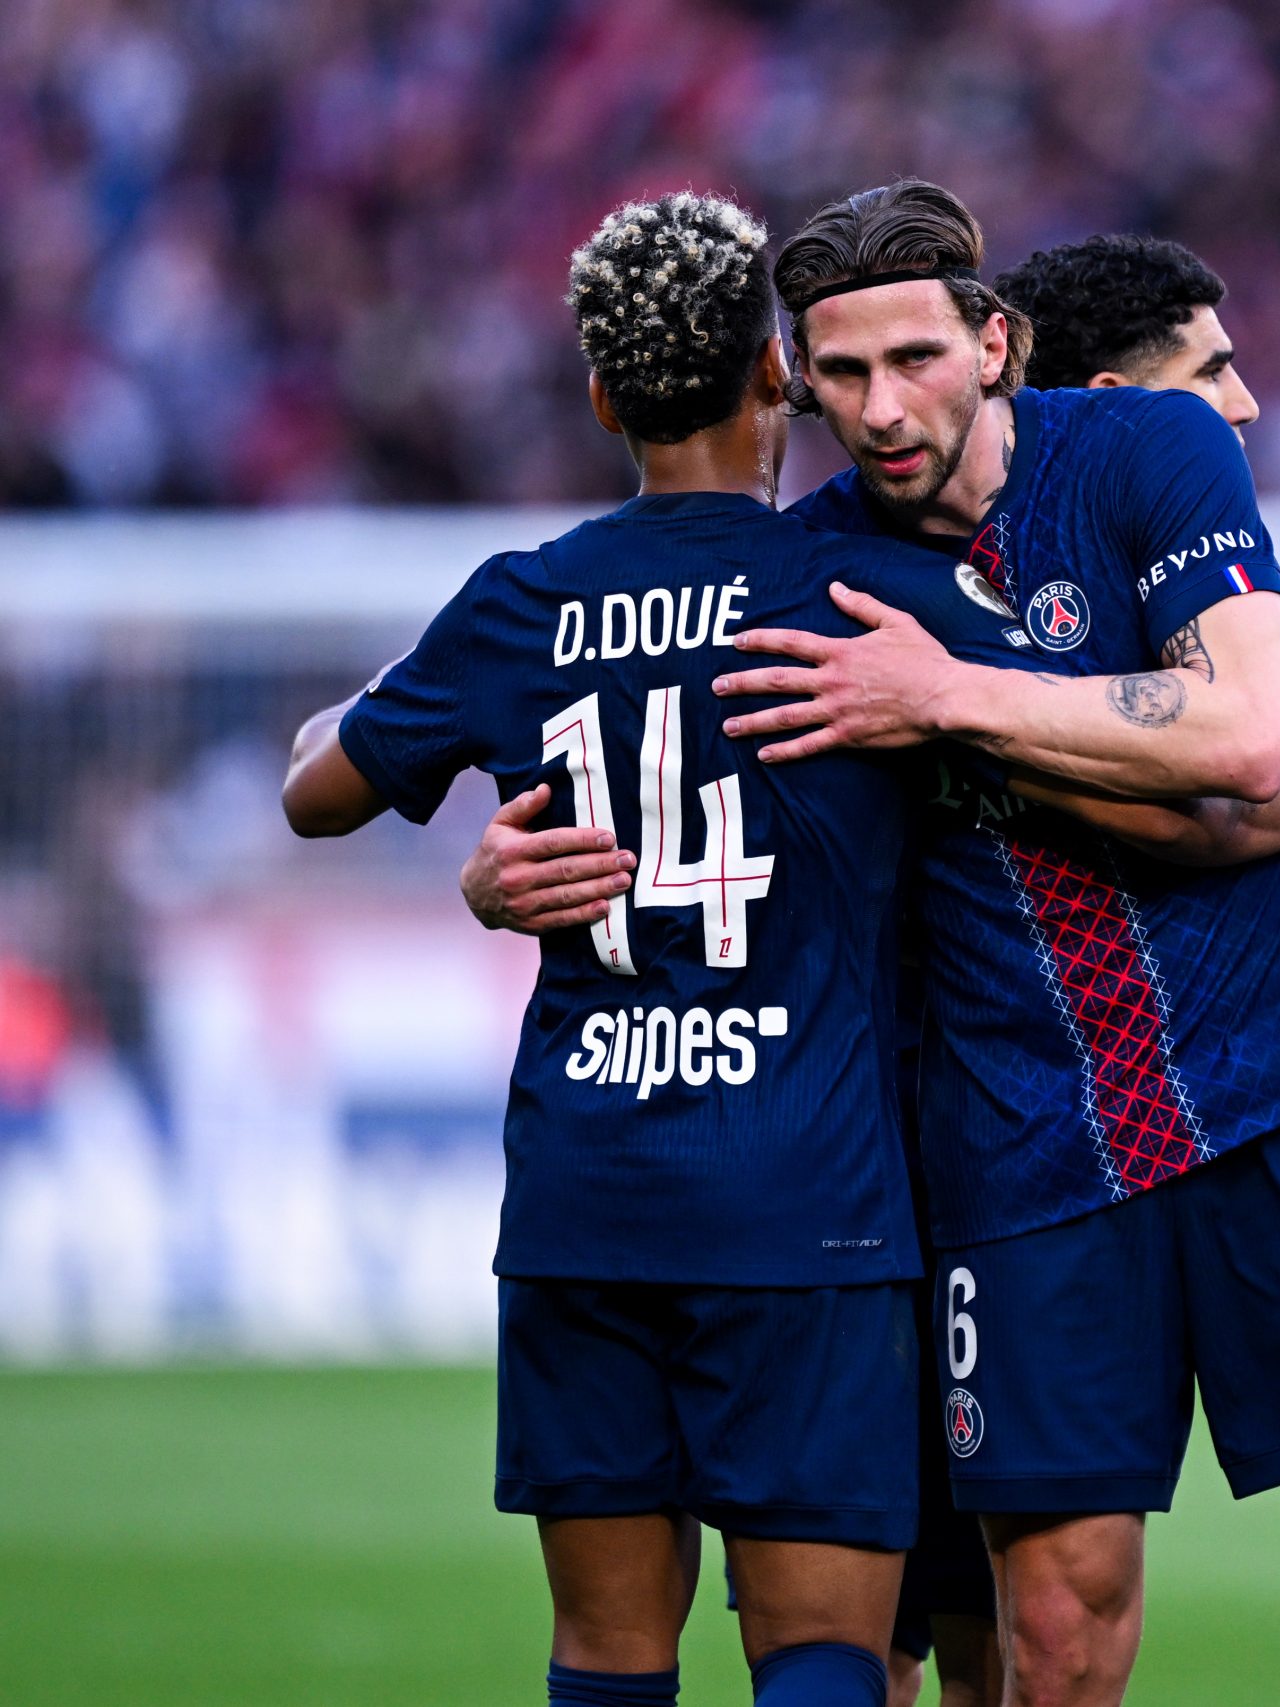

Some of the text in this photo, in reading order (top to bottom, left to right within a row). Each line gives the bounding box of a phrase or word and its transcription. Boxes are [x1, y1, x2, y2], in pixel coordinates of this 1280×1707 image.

[554, 575, 750, 667] D.DOUÉ
[1033, 585, 1073, 609] PARIS
[541, 685, 776, 976] 14
[565, 1006, 757, 1100] snipes
[947, 1267, 978, 1380] 6
[949, 1391, 974, 1410] PARIS
